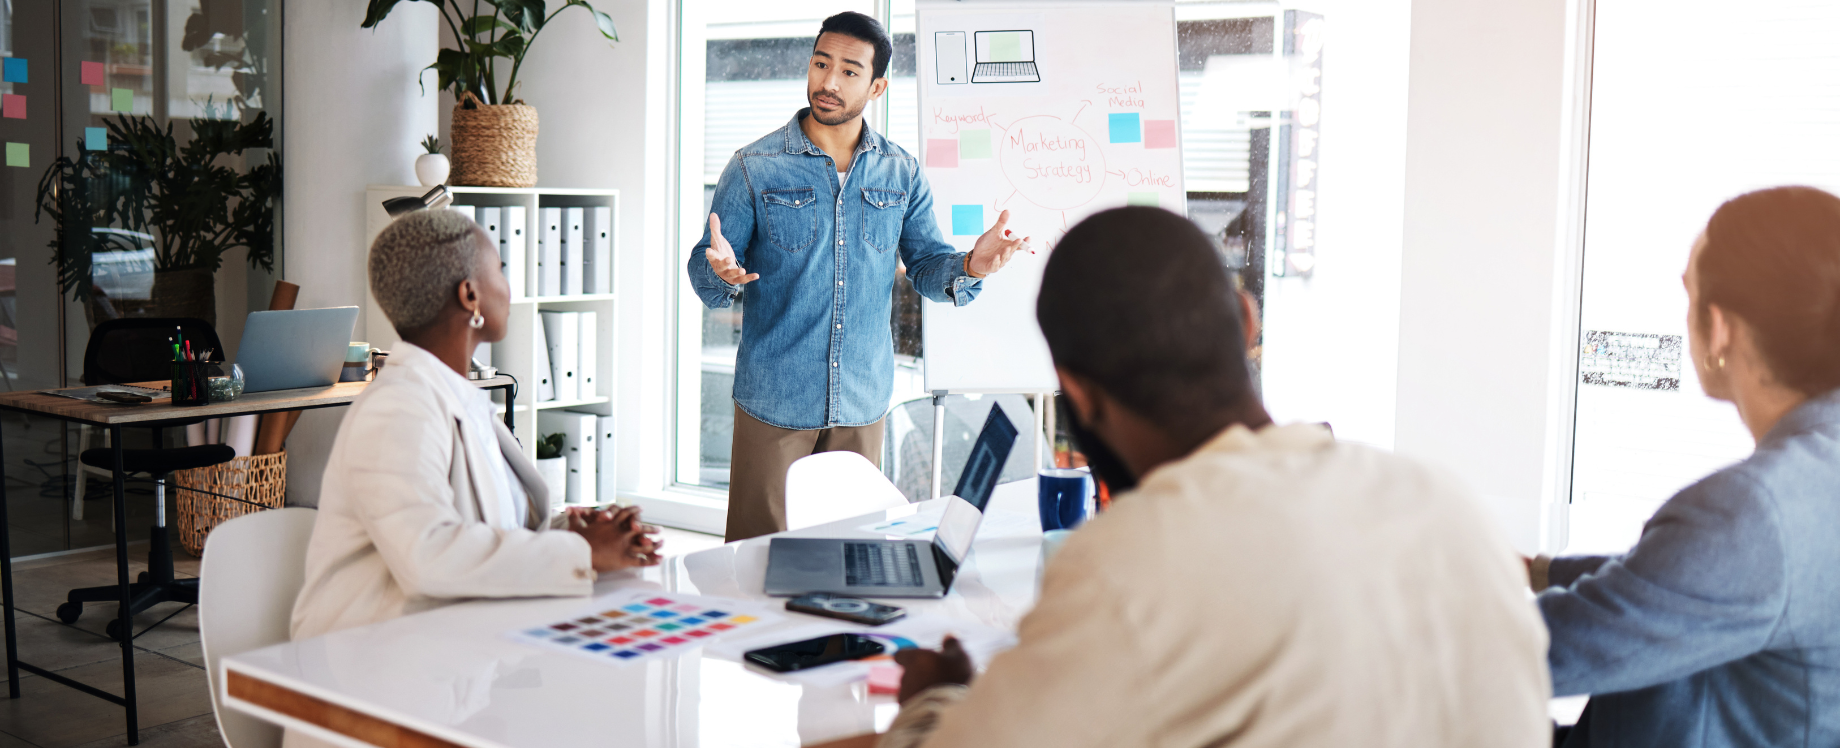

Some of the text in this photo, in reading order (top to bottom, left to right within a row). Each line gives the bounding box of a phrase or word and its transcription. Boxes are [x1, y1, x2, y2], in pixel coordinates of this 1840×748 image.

[1096, 81, 1142, 94] Social
[1108, 97, 1145, 109] Media
[1010, 128, 1086, 161] Marketing
[1023, 157, 1092, 184] Strategy
[1126, 167, 1175, 188] Online
